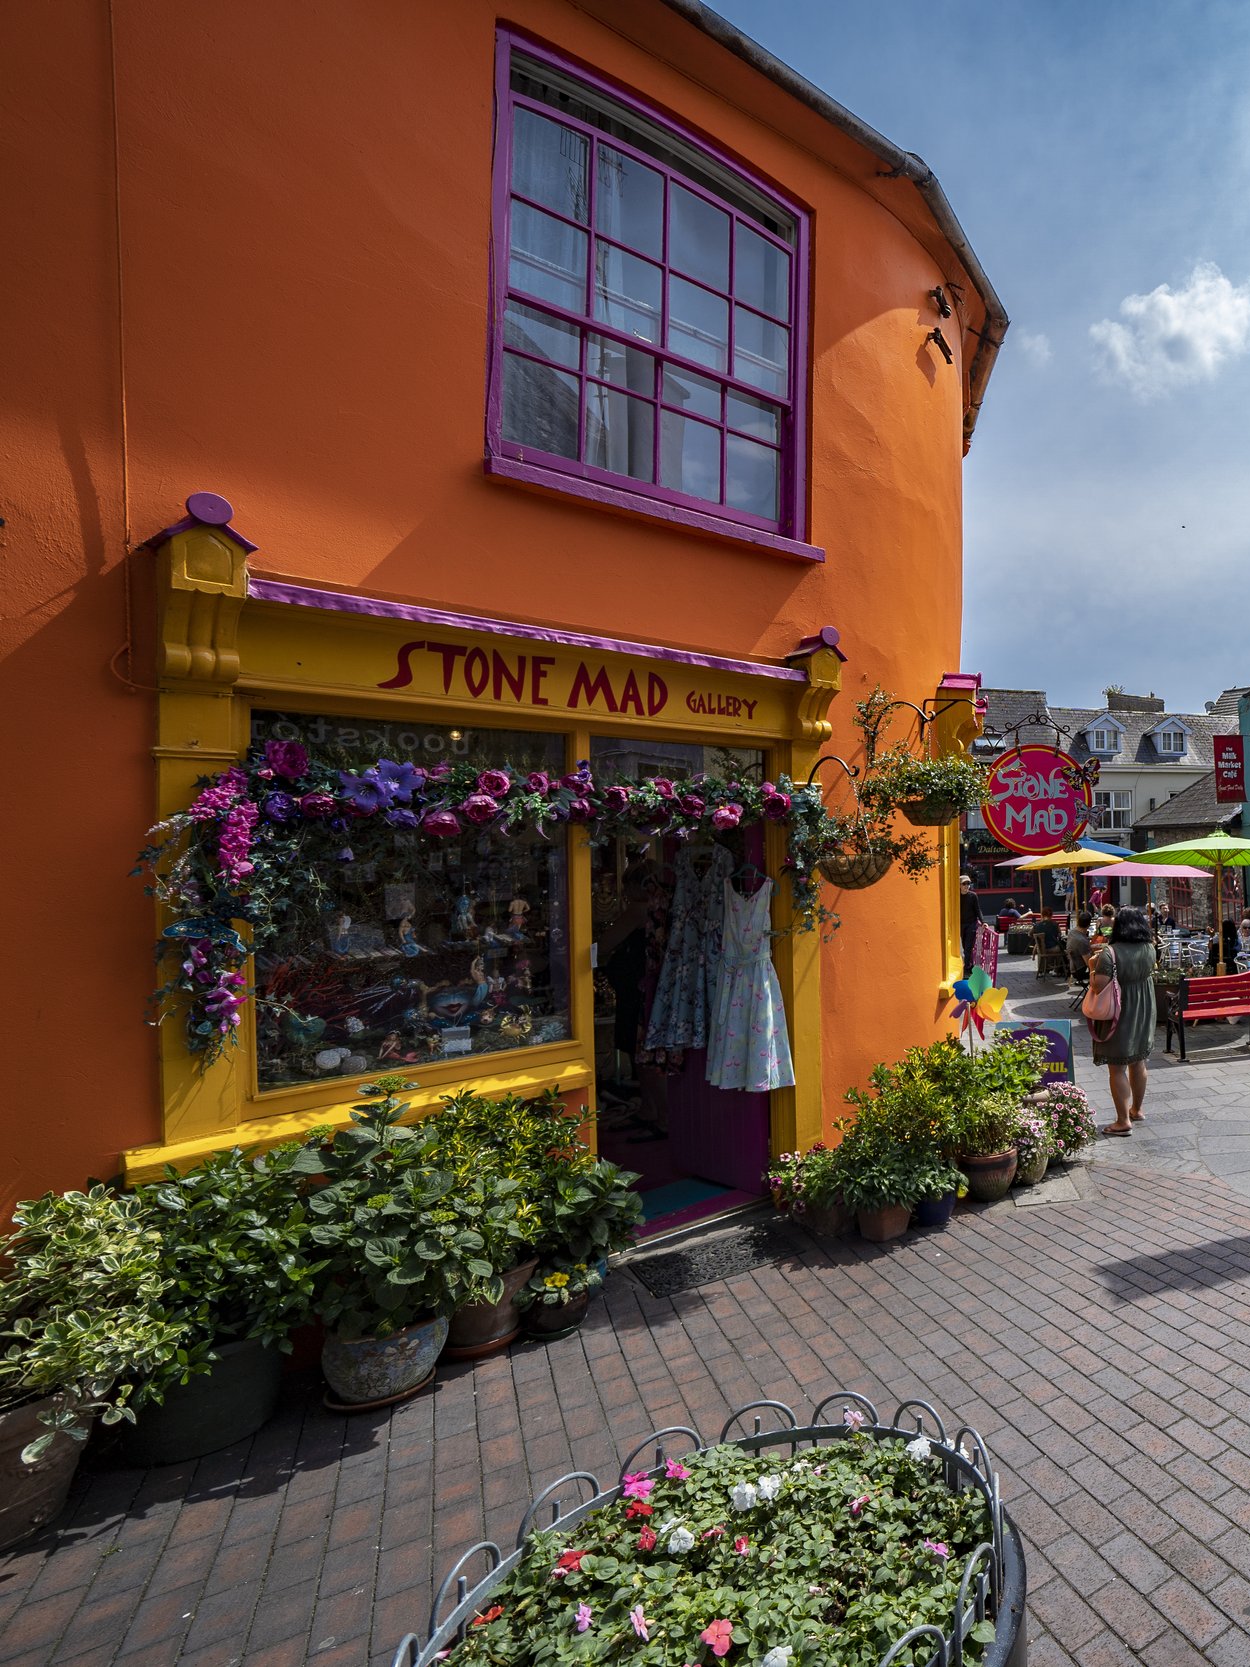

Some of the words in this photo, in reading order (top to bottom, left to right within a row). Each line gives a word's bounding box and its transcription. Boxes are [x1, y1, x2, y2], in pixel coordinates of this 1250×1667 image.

[377, 640, 556, 706] STONE
[566, 661, 669, 717] MAD
[685, 689, 758, 720] GALLERY
[1221, 752, 1237, 760] Milk
[988, 758, 1069, 810] STONE
[1003, 803, 1068, 837] MAD
